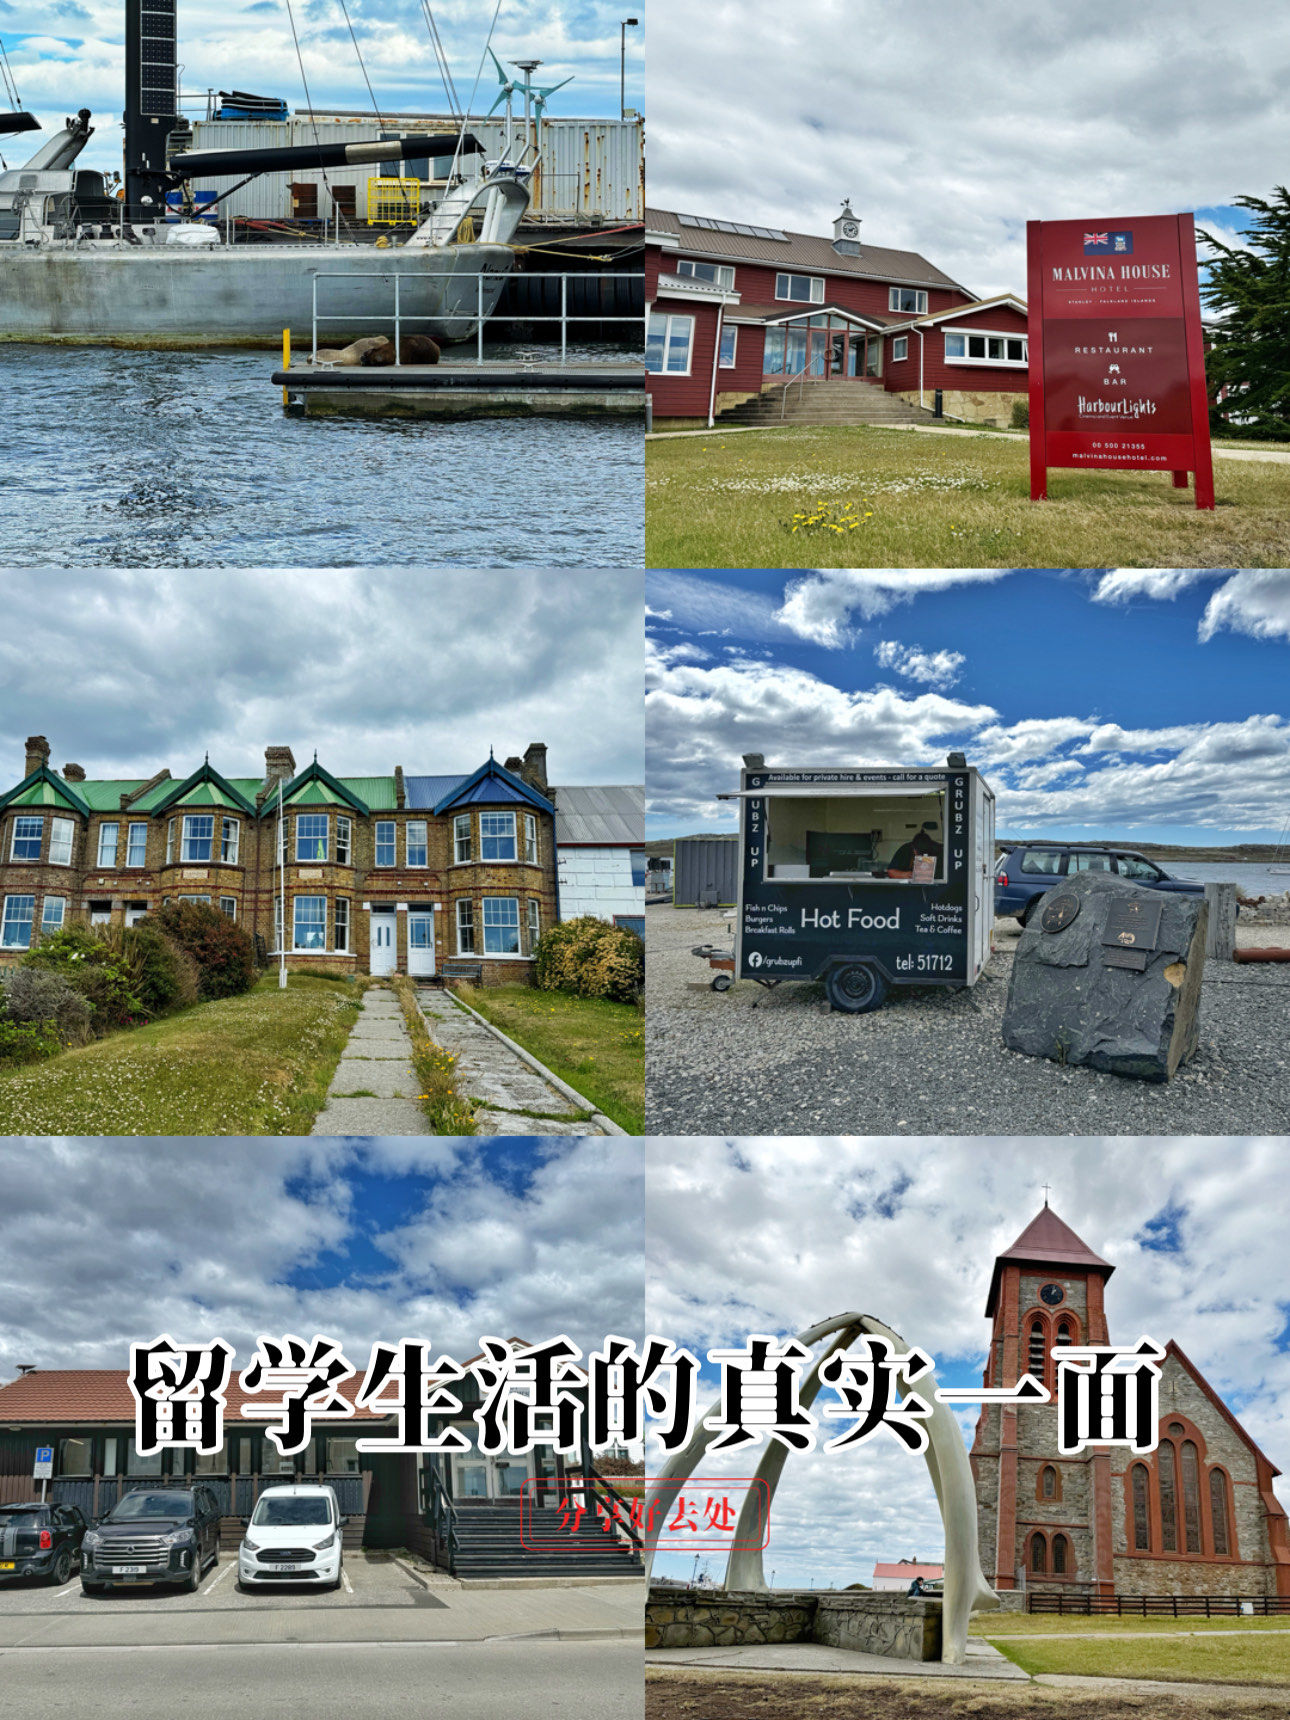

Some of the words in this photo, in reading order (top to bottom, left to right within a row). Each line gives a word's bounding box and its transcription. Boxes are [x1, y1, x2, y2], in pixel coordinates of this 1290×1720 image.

[1052, 265, 1115, 281] MALVINA
[1120, 264, 1170, 279] HOUSE
[1103, 378, 1127, 386] BAR
[1072, 453, 1168, 462] malvinahousehotel.com
[768, 773, 800, 781] Available
[801, 773, 812, 781] for
[813, 774, 839, 782] private
[906, 773, 917, 781] for
[924, 774, 946, 782] quote
[751, 777, 761, 833] GUBZ
[954, 777, 964, 835] GRUBZ
[750, 846, 760, 868] UP
[954, 848, 964, 871] UP
[745, 904, 760, 912] Fish
[767, 904, 788, 914] Chips
[931, 903, 963, 914] Hotdogs
[745, 915, 774, 925] Burgers
[801, 908, 841, 929] Hot
[847, 907, 900, 929] Food
[920, 913, 937, 923] Soft
[938, 914, 962, 923] Drinks
[745, 925, 778, 934] Breakfast
[779, 926, 796, 934] Rolls
[915, 925, 929, 933] Tea
[929, 925, 936, 933] &
[937, 925, 963, 935] Coffee
[896, 953, 915, 971] tel:
[917, 954, 953, 971] 51712
